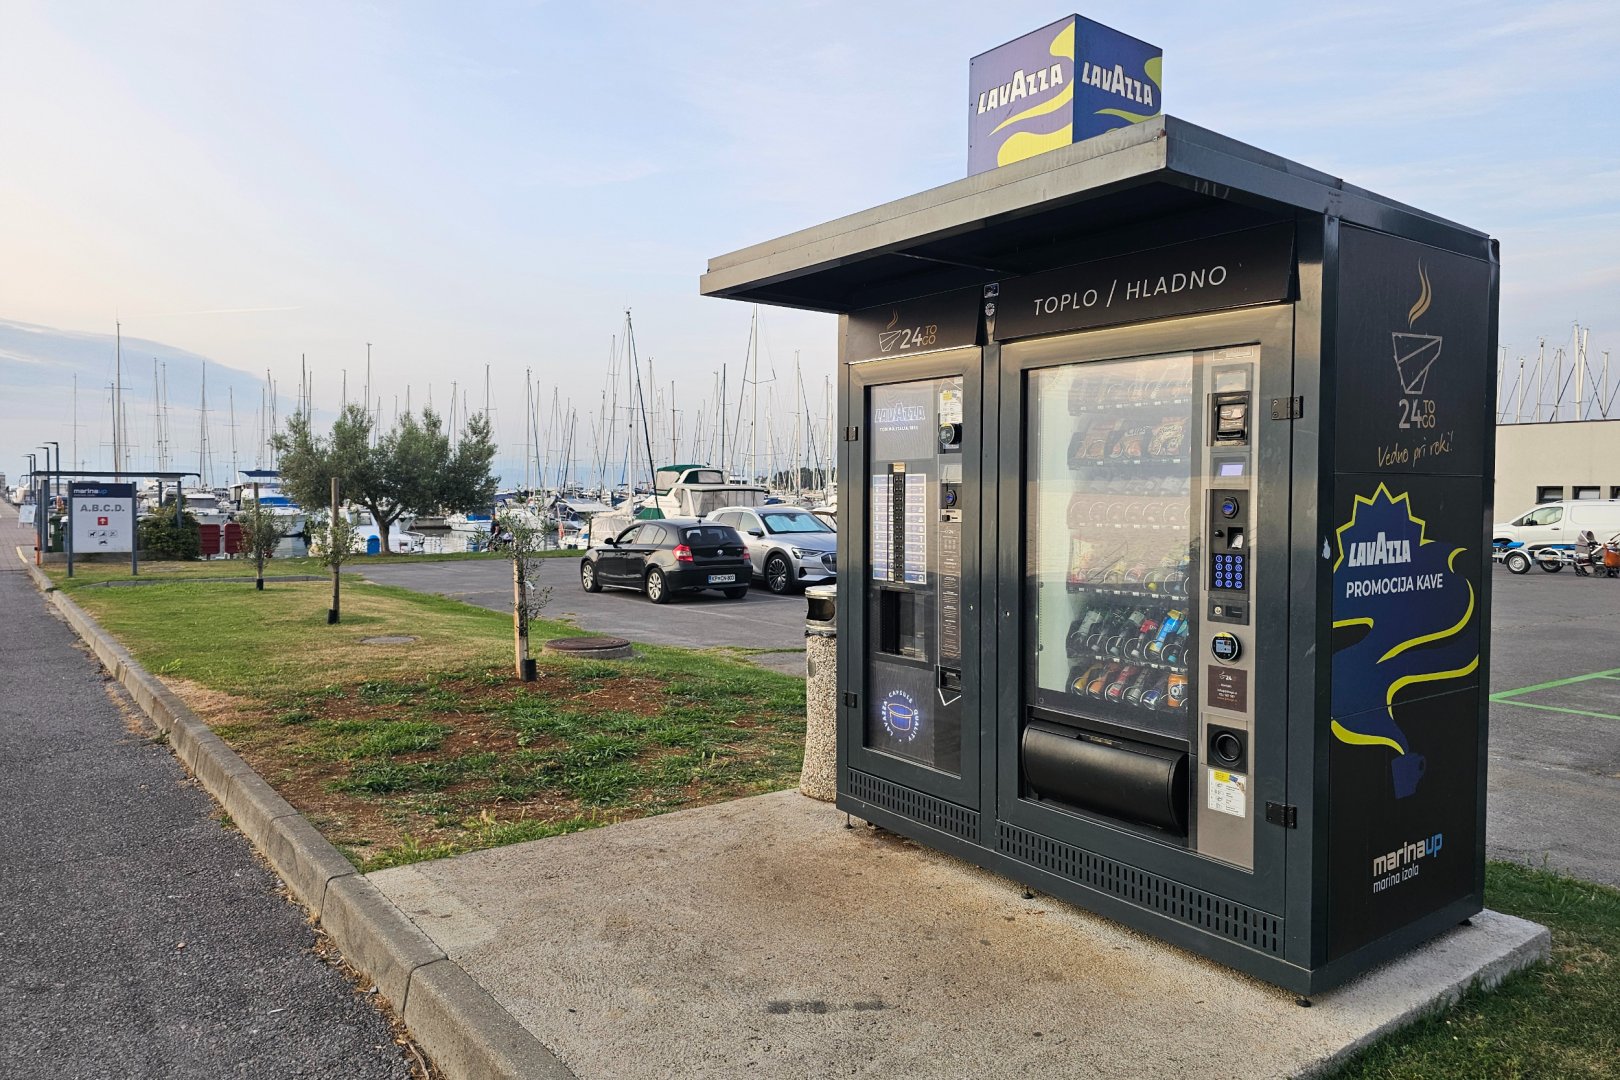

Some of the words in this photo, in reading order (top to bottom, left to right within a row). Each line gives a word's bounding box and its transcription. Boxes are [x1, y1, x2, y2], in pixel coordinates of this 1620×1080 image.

[976, 62, 1064, 115] LAVAZZA
[1081, 61, 1154, 107] LAVAZZA
[1034, 289, 1098, 316] TOPLO
[1126, 265, 1227, 300] HLADNO
[900, 326, 923, 349] 24
[925, 324, 938, 336] TO
[922, 335, 937, 346] GO
[874, 401, 926, 424] LAVAZZA
[1398, 398, 1423, 429] 24
[1423, 400, 1436, 414] TO
[1421, 414, 1436, 428] GO
[1378, 442, 1409, 468] Vedno
[1412, 436, 1427, 468] pri
[80, 504, 125, 512] A.B.C.D.
[1348, 531, 1412, 568] LAVAZZA
[1346, 575, 1414, 599] PROMOCIJA
[1416, 573, 1444, 591] KAVE
[889, 690, 912, 703] CAPSULE
[881, 701, 893, 736] LAVAZZA
[908, 709, 919, 741] QUALITY
[1373, 833, 1443, 877] marinaup
[1373, 872, 1401, 894] marina
[1401, 862, 1419, 881] izola
